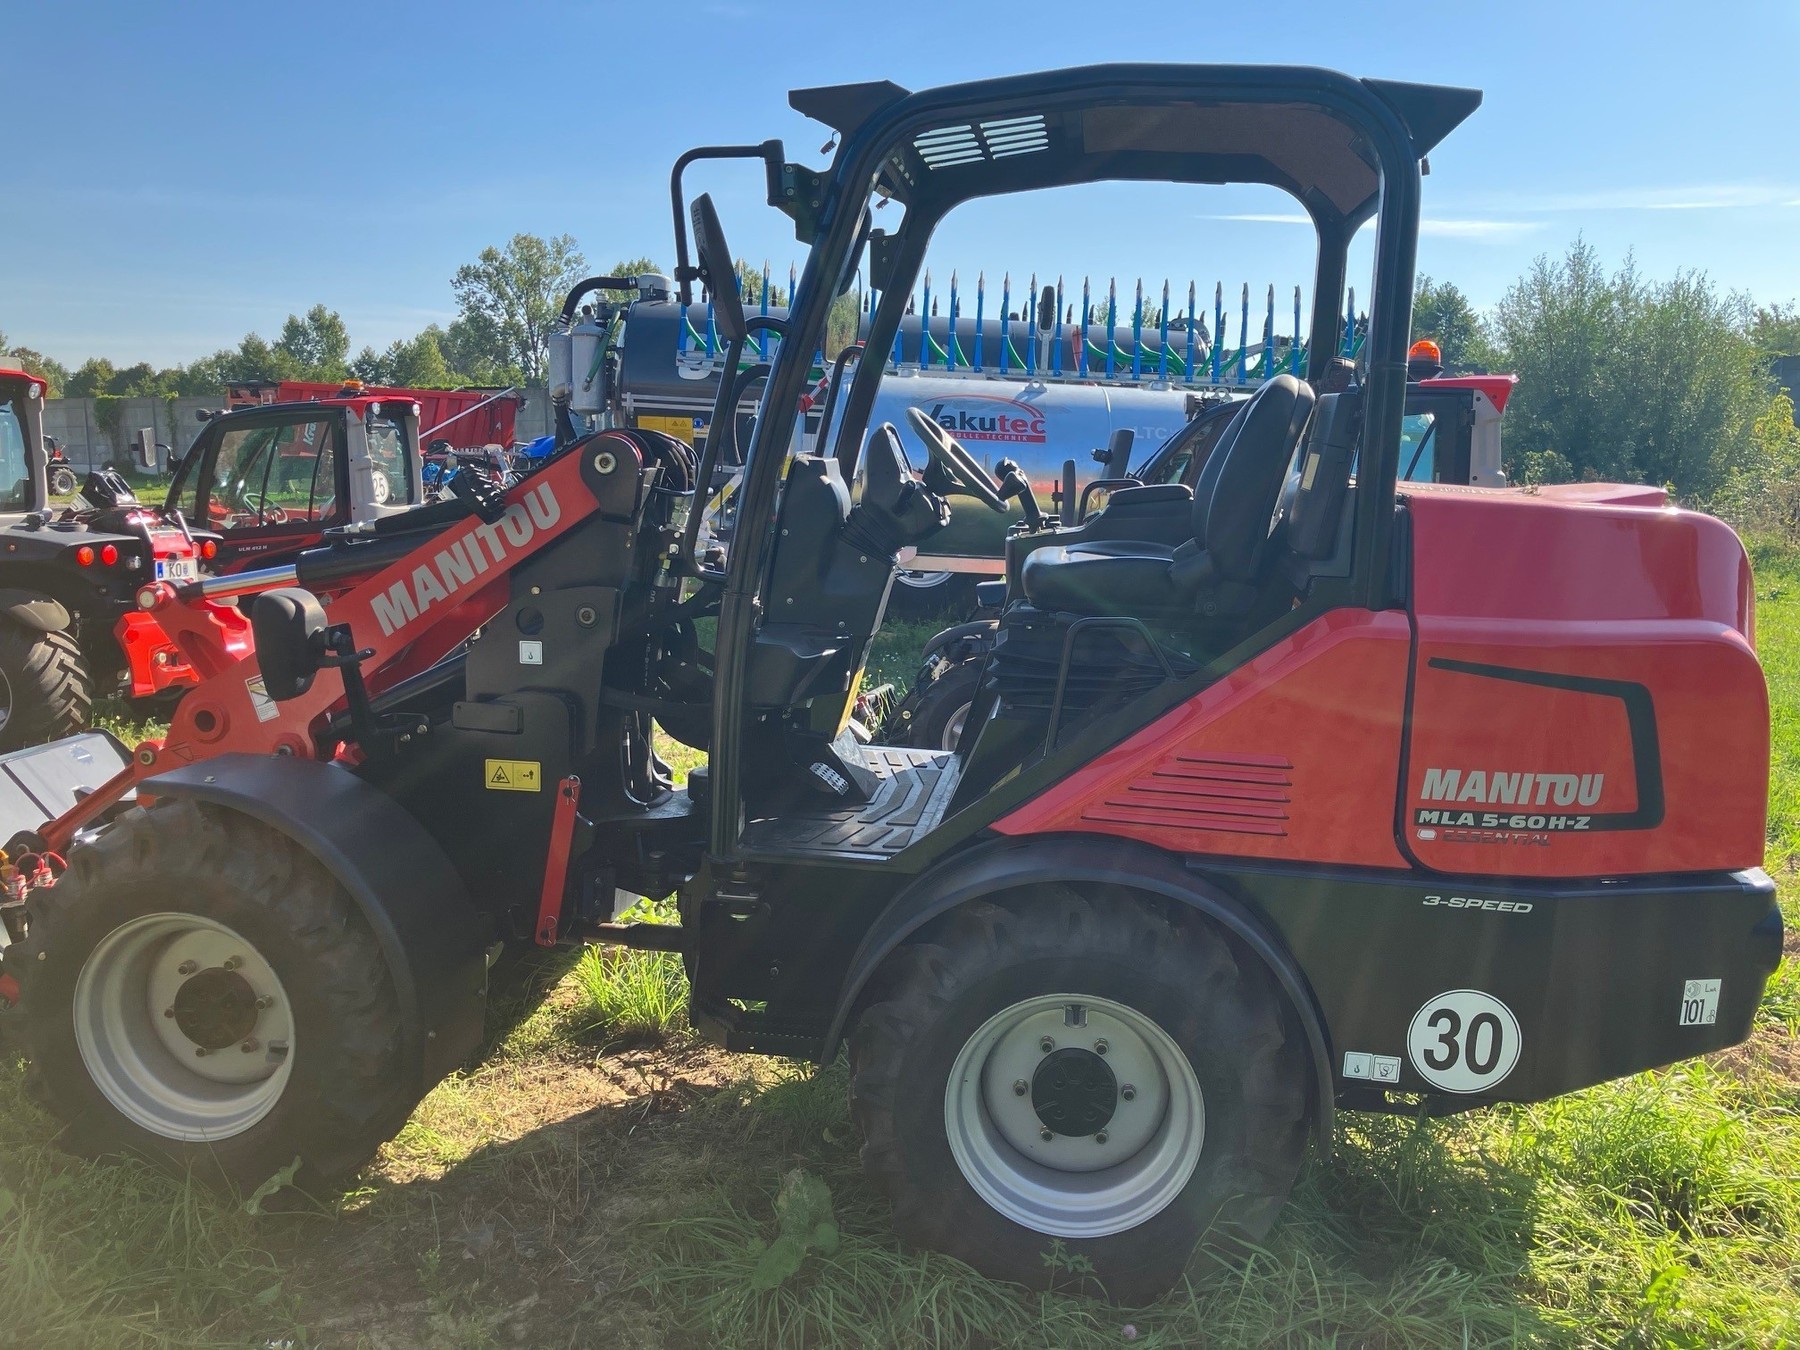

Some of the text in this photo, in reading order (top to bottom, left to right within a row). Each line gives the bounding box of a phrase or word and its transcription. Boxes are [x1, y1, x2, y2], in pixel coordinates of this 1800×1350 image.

[369, 481, 561, 637] MANITOU
[1420, 768, 1604, 807] MANITOU
[1418, 811, 1475, 826] MLA
[1441, 829, 1551, 847] ESSENTIAL
[1422, 895, 1534, 914] 3-SPEED
[1683, 998, 1706, 1024] 101
[1423, 1008, 1504, 1076] 30
